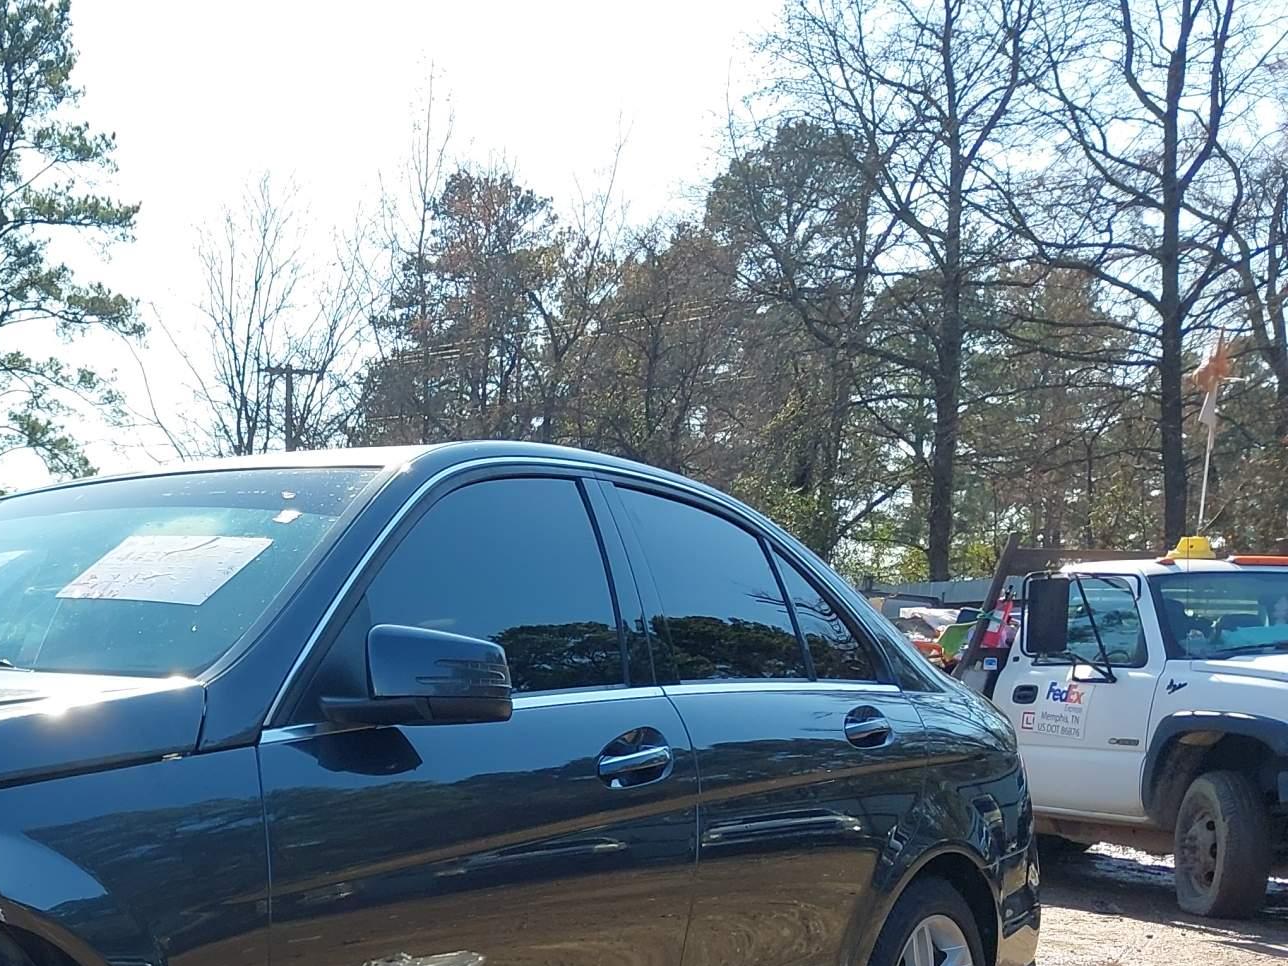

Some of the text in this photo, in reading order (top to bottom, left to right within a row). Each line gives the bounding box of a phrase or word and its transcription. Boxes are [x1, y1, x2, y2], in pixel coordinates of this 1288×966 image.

[1046, 682, 1084, 704] FedEx
[1072, 714, 1080, 724] TN
[1046, 723, 1060, 733] DOT
